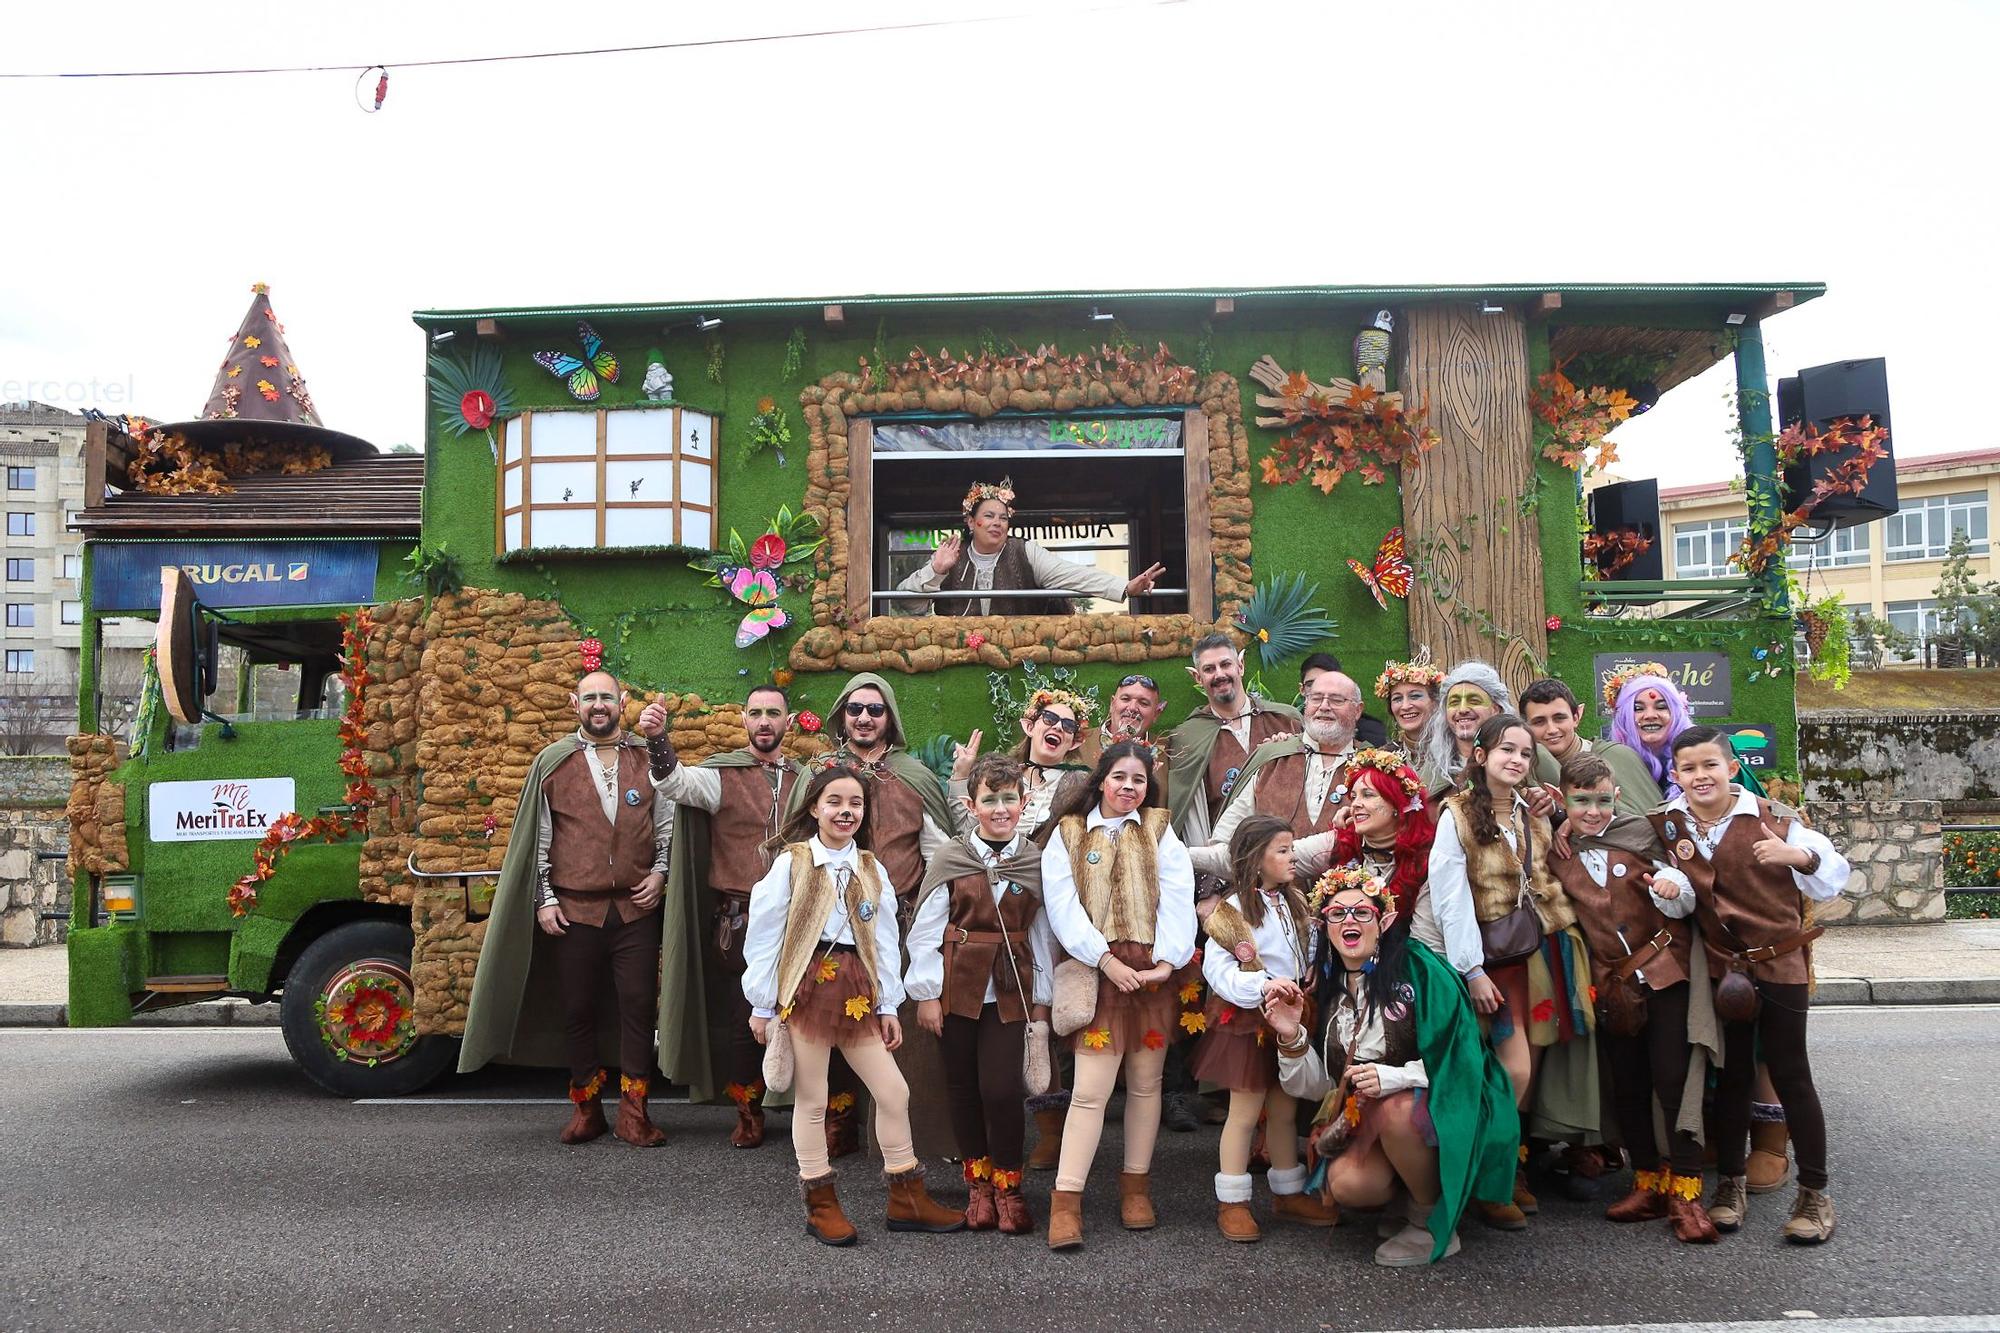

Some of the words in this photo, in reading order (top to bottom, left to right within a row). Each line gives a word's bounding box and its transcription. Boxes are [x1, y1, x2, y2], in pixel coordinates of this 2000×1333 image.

[2, 373, 134, 403] ercotel
[160, 563, 283, 584] RUGAL
[1739, 754, 1765, 765] ña
[212, 783, 251, 810] MTE
[176, 808, 267, 830] MeriTraEx
